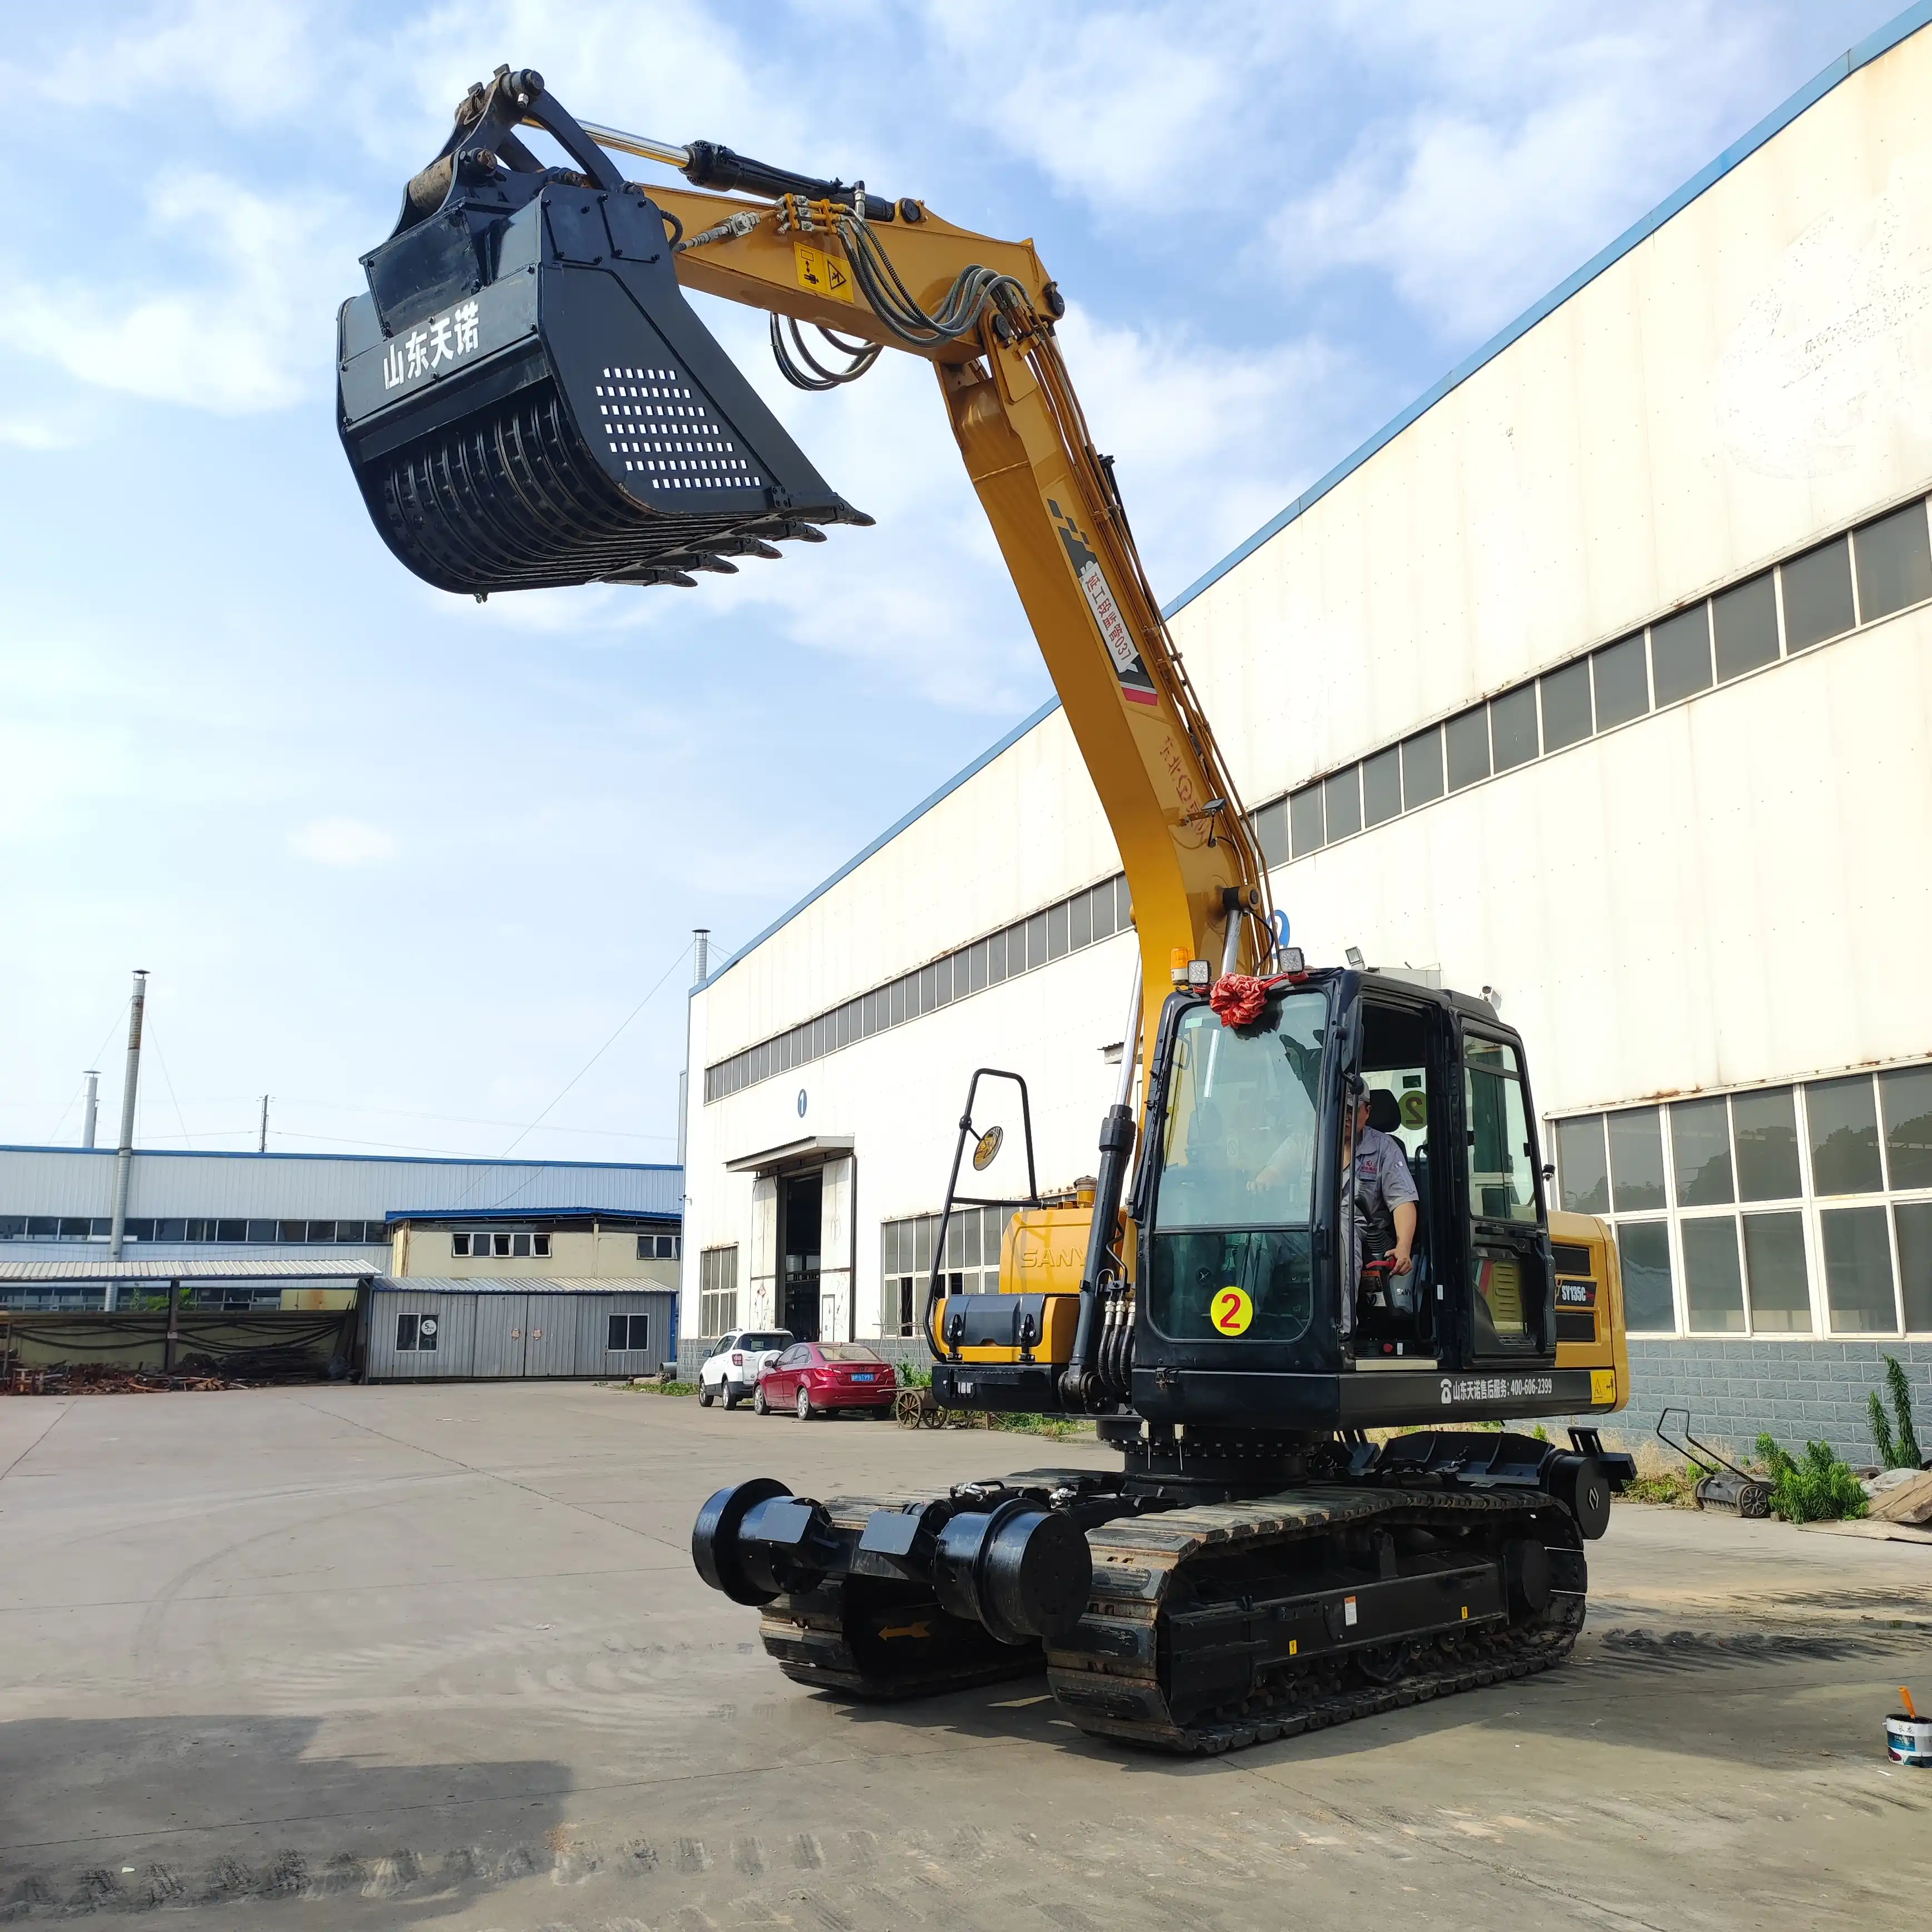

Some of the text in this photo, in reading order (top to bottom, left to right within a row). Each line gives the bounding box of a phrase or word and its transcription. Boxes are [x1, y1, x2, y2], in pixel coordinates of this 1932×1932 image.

[384, 300, 479, 390] 山东天诺
[1085, 571, 1132, 661] 延工段监管037
[1220, 1294, 1240, 1328] 2
[1561, 1285, 1586, 1302] SY135C
